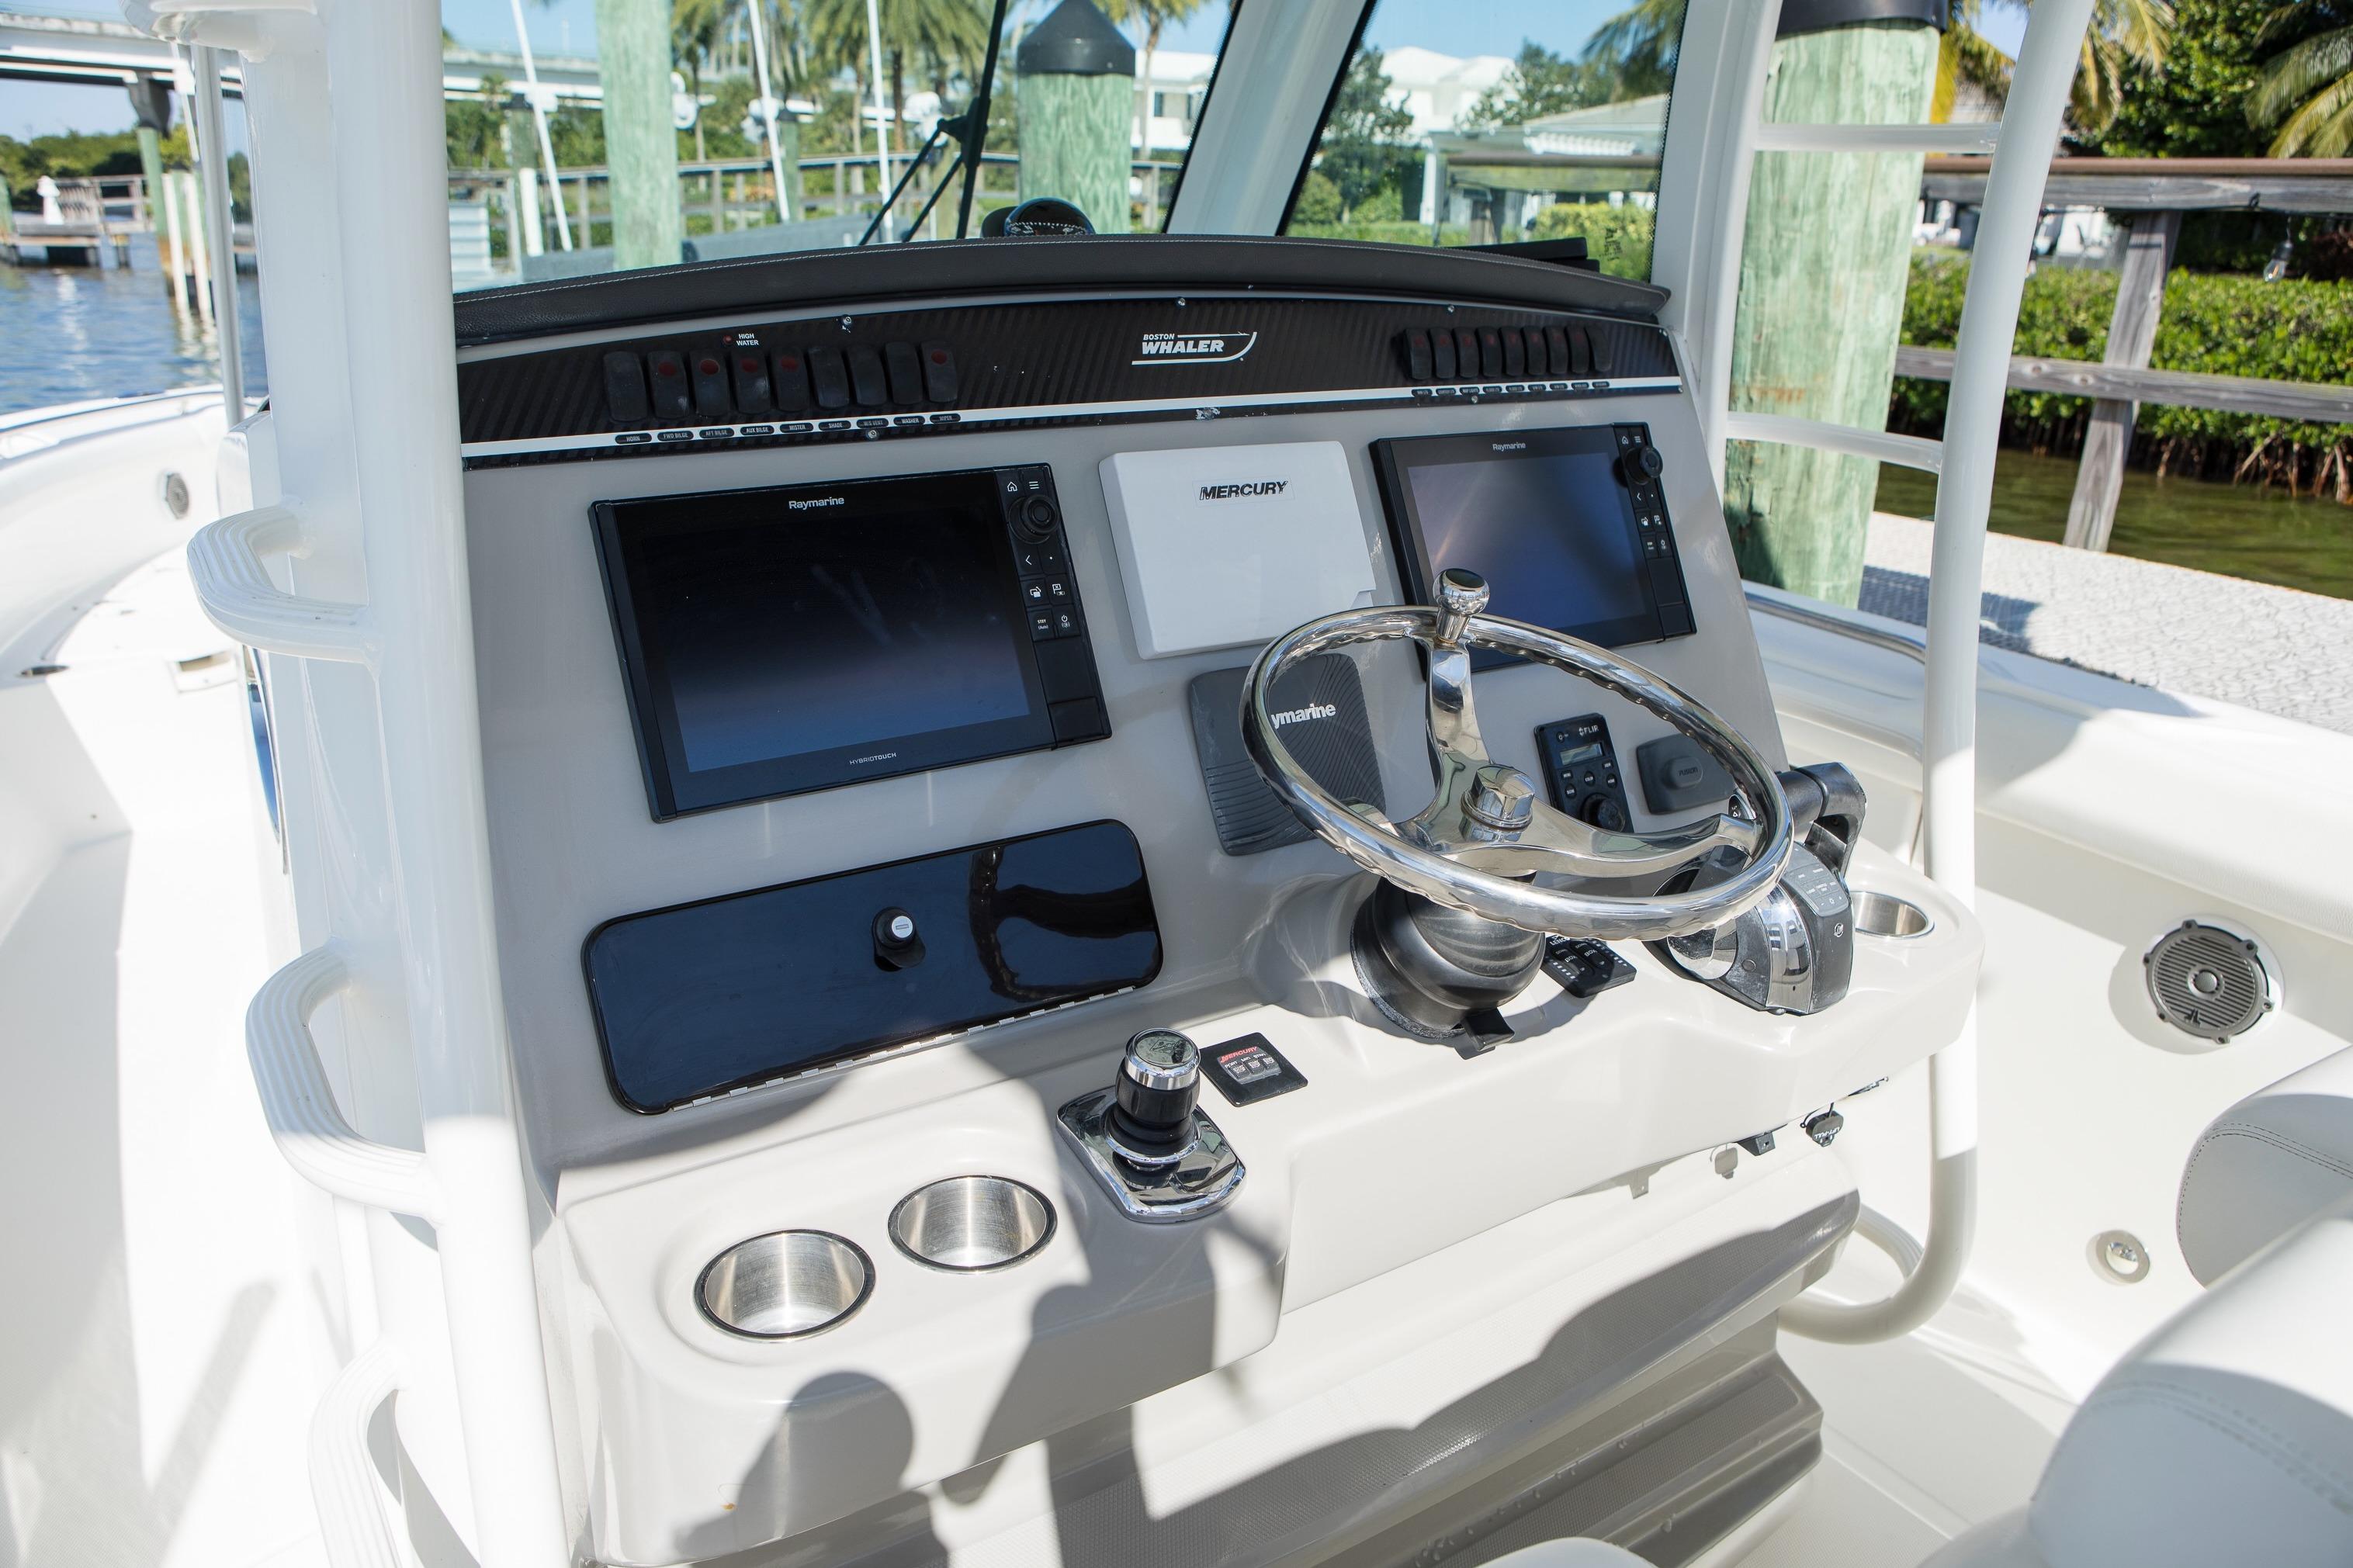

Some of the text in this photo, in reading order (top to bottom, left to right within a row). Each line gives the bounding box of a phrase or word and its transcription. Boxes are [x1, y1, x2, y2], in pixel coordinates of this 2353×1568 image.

[1142, 340, 1225, 355] WHALER
[1492, 441, 1527, 452] Raymarine
[1199, 480, 1288, 500] MERCURY
[788, 497, 844, 511] Raymarine
[1270, 703, 1336, 729] ymarine
[1583, 725, 1599, 734] FLIR
[1549, 936, 1571, 946] LENCO
[1220, 1046, 1257, 1063] MERCURY
